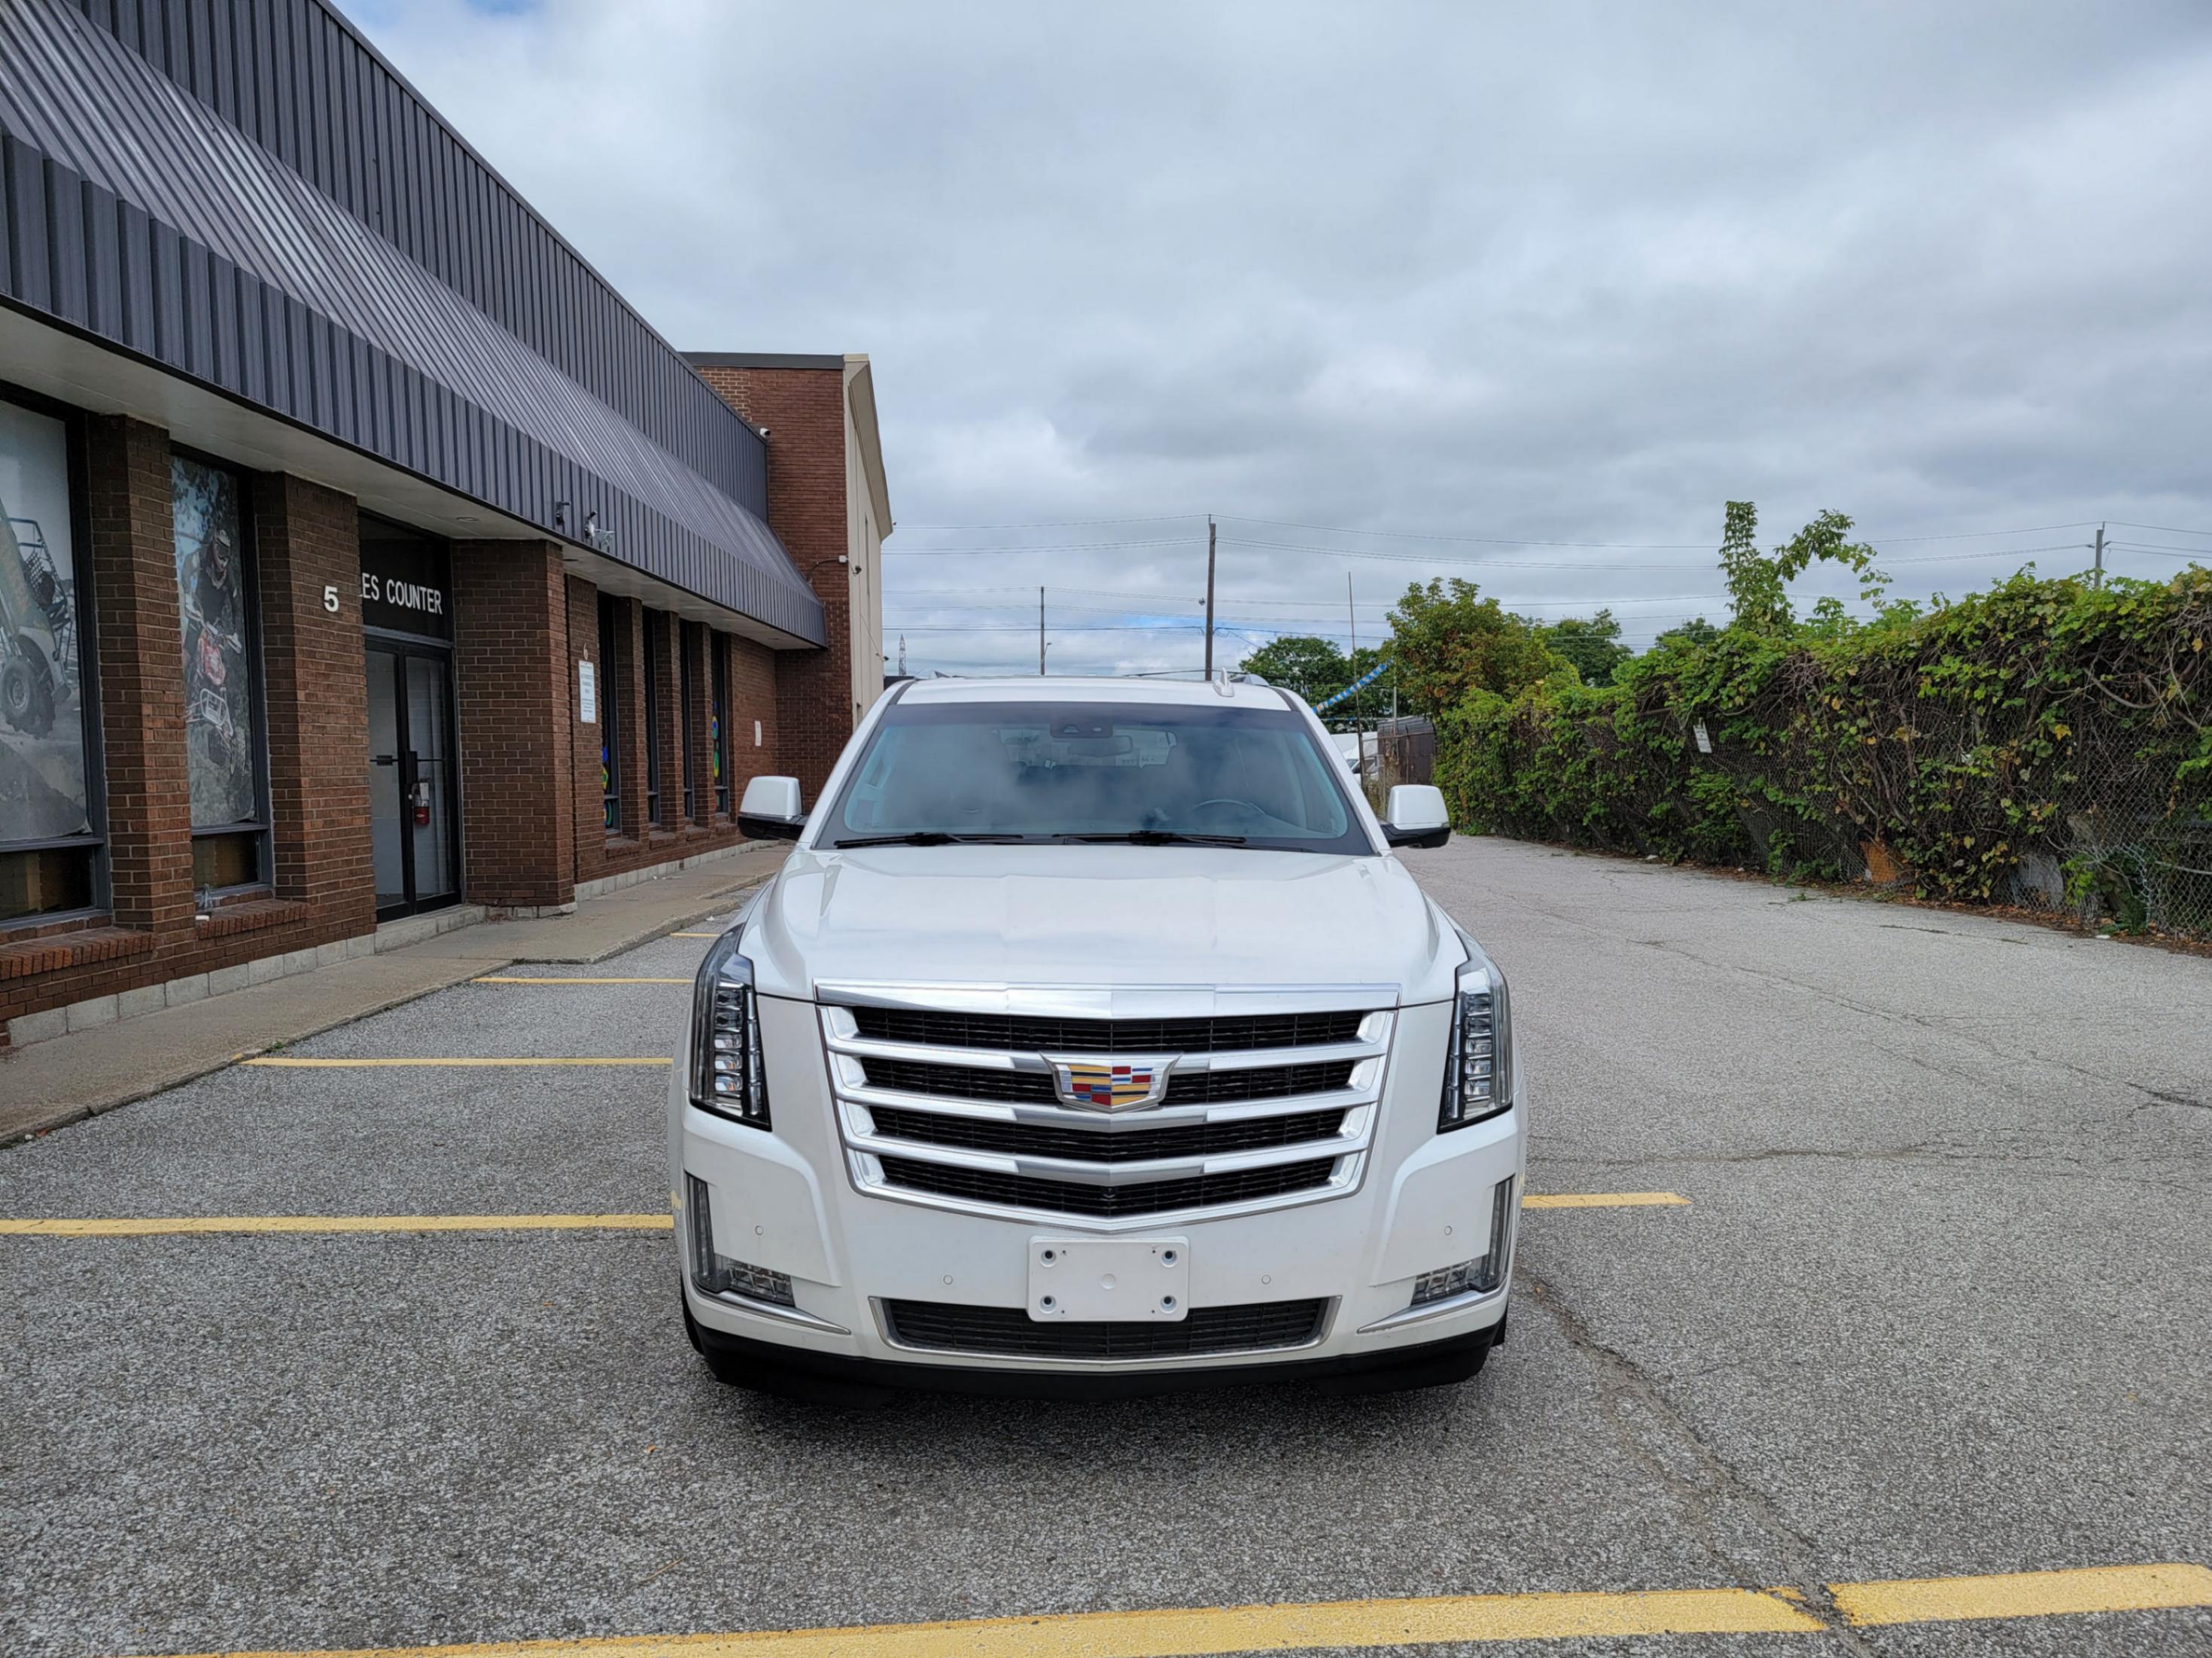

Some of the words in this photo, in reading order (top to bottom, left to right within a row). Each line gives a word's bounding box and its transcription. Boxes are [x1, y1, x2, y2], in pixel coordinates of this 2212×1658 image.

[324, 585, 339, 613] 5
[360, 572, 380, 601] ES
[386, 579, 443, 614] COUNTER
[583, 643, 589, 660] 6
